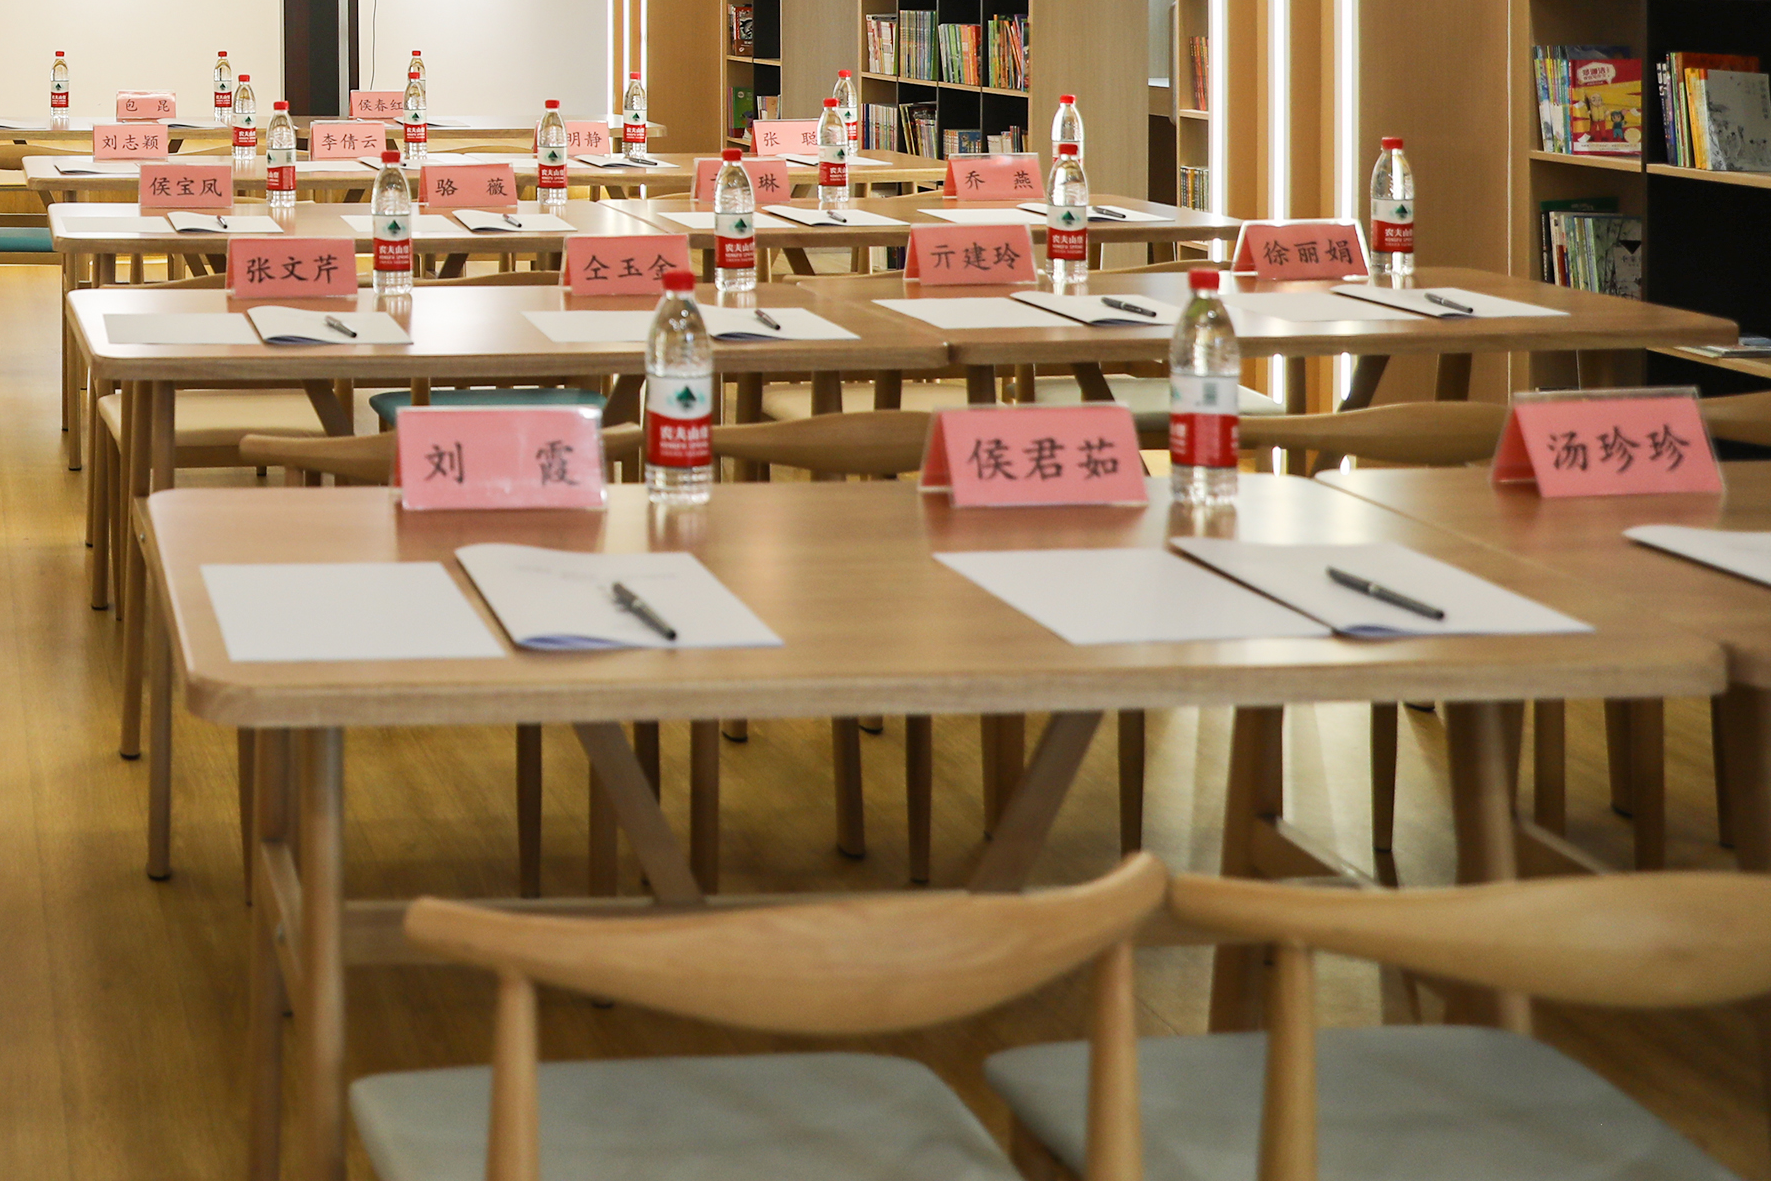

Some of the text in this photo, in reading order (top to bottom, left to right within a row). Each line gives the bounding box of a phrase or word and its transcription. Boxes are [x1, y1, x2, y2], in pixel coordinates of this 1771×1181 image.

[125, 98, 170, 113] 包昆
[358, 98, 404, 112] 侯春红
[101, 134, 160, 152] 刘志颖
[321, 133, 378, 152] 李倩云
[567, 131, 602, 148] 明静
[763, 131, 819, 147] 张聪
[150, 177, 223, 197] 侯宝凤
[435, 177, 508, 197] 骆薇
[965, 170, 1033, 190] 乔燕
[931, 242, 1021, 271] 亓建玲
[1264, 239, 1354, 266] 徐丽娟
[246, 254, 339, 284] 张文芹
[584, 254, 677, 281] 仝玉金
[1548, 424, 1690, 473] 汤珍珍
[427, 440, 576, 485] 刘霞
[970, 437, 1119, 481] 侯君茹
